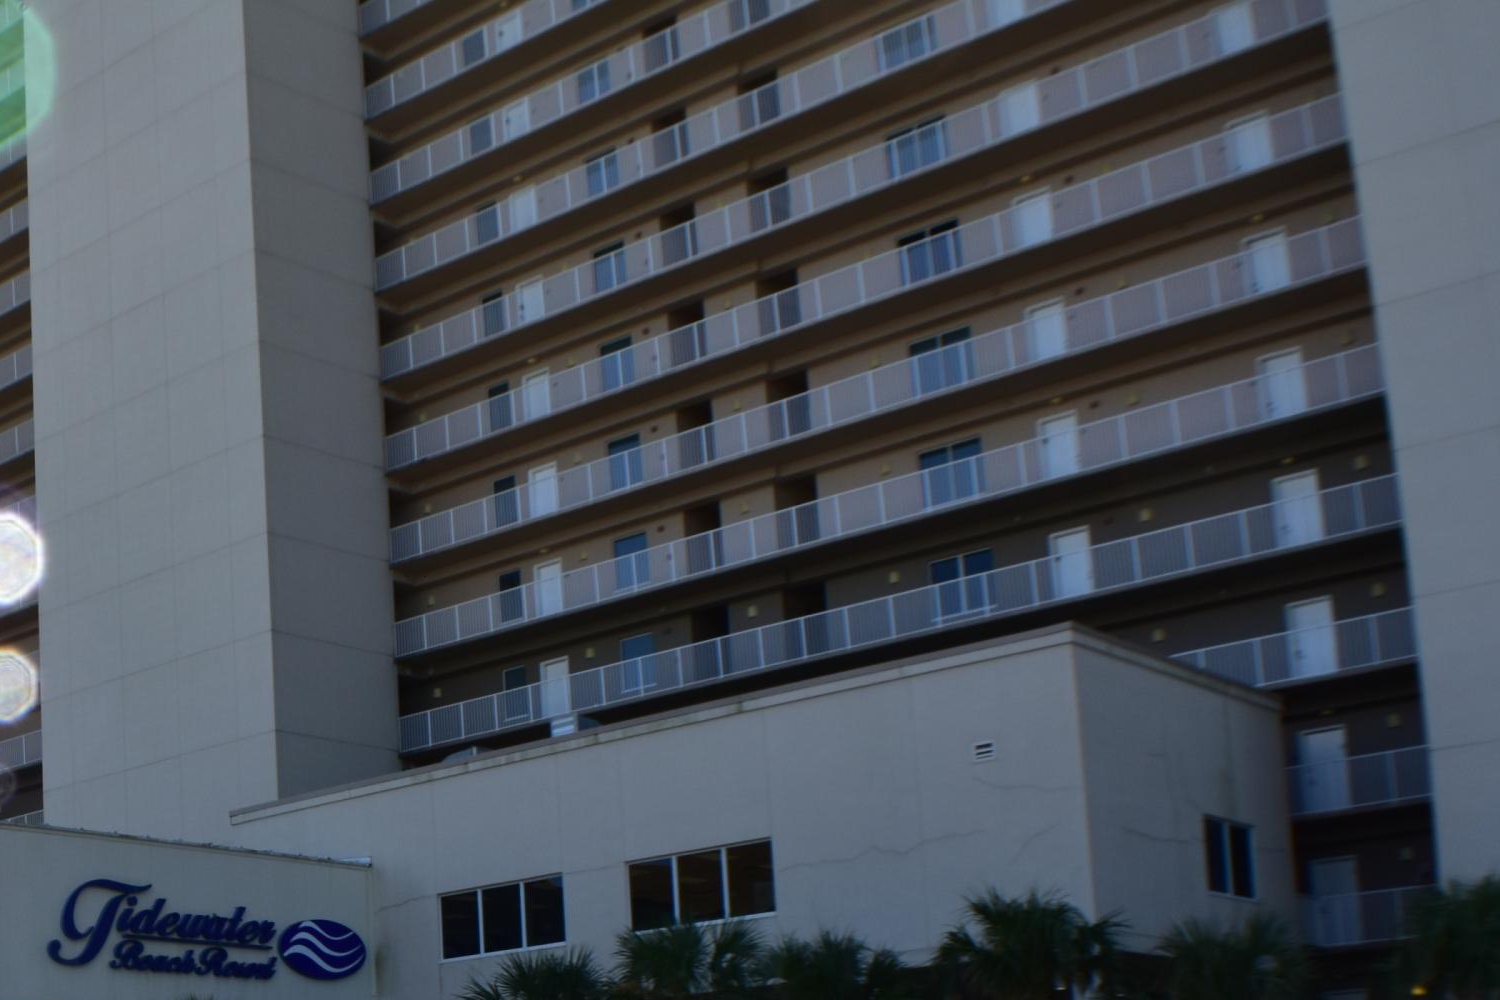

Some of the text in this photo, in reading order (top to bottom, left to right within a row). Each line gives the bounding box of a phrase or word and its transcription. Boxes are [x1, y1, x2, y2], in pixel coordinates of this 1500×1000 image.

[47, 879, 276, 966] Tidewater
[109, 939, 277, 979] Beach Resort
